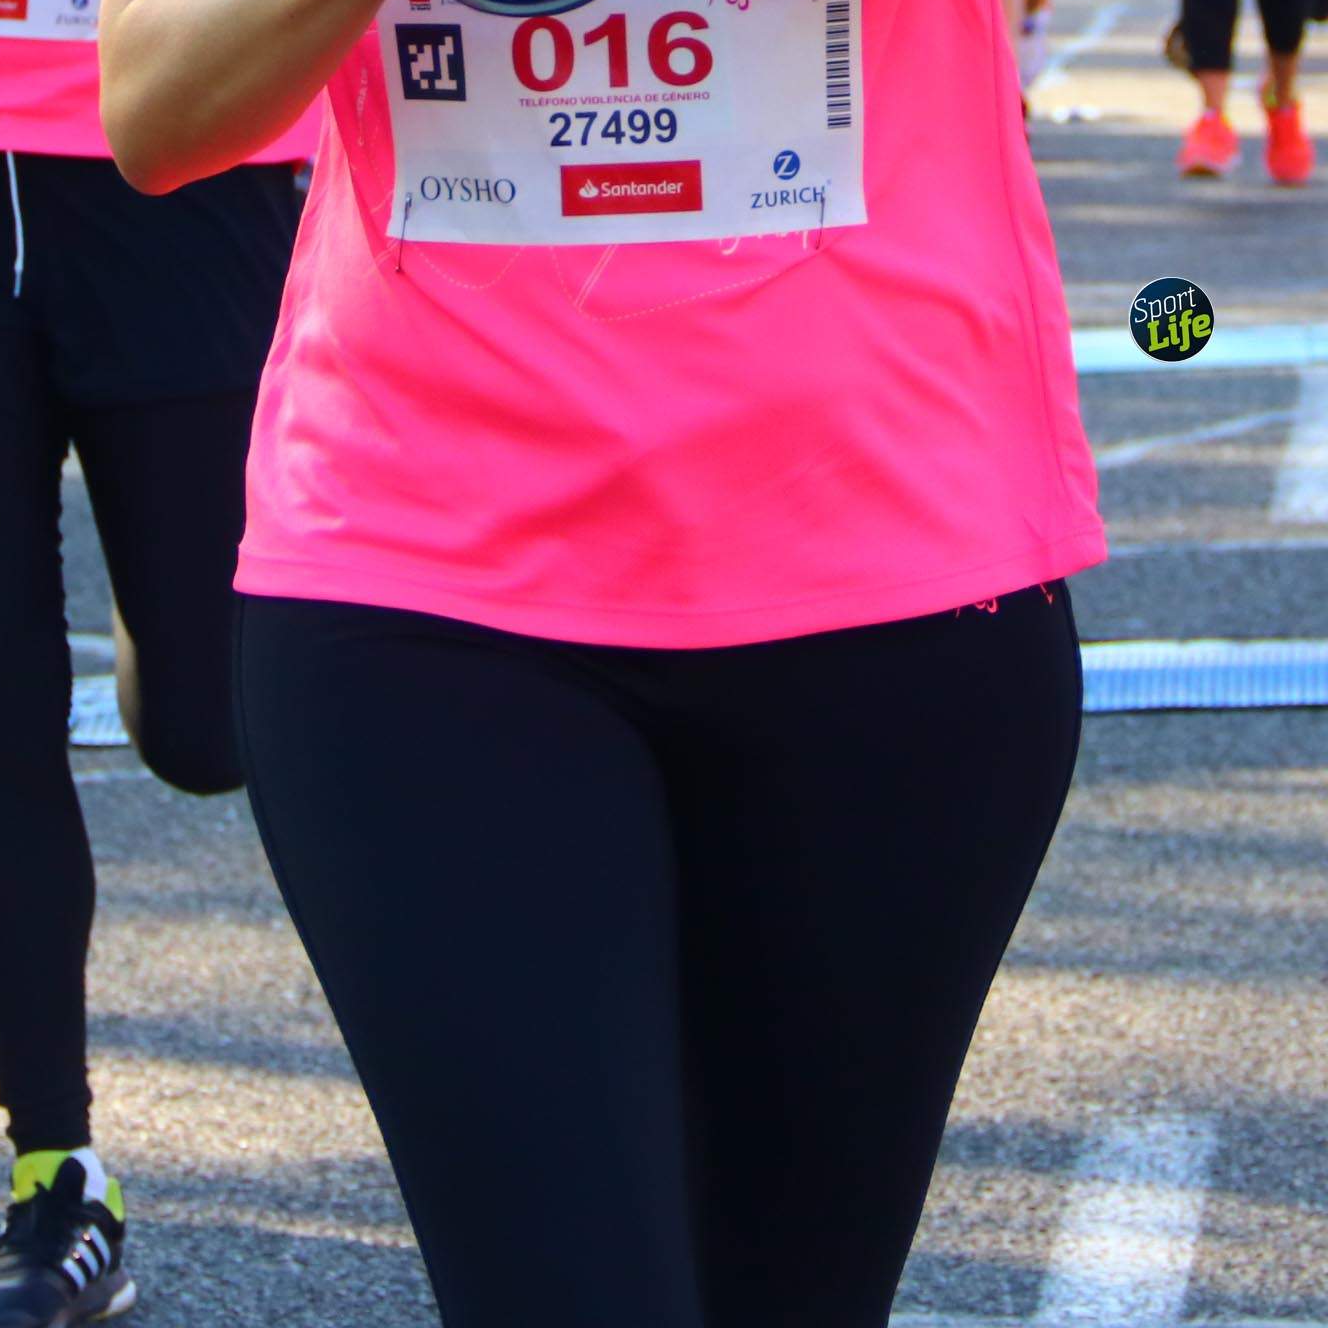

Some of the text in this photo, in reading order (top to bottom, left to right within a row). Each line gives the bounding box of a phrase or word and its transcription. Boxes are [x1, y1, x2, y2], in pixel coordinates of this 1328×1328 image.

[510, 11, 714, 93] 016
[519, 97, 577, 107] TELÉFONO
[581, 94, 641, 105] VIOLENCIA
[644, 93, 658, 103] DE
[549, 108, 678, 147] 27499
[420, 175, 516, 204] OYSHO
[601, 179, 684, 198] Santander
[750, 185, 825, 209] ZURICH
